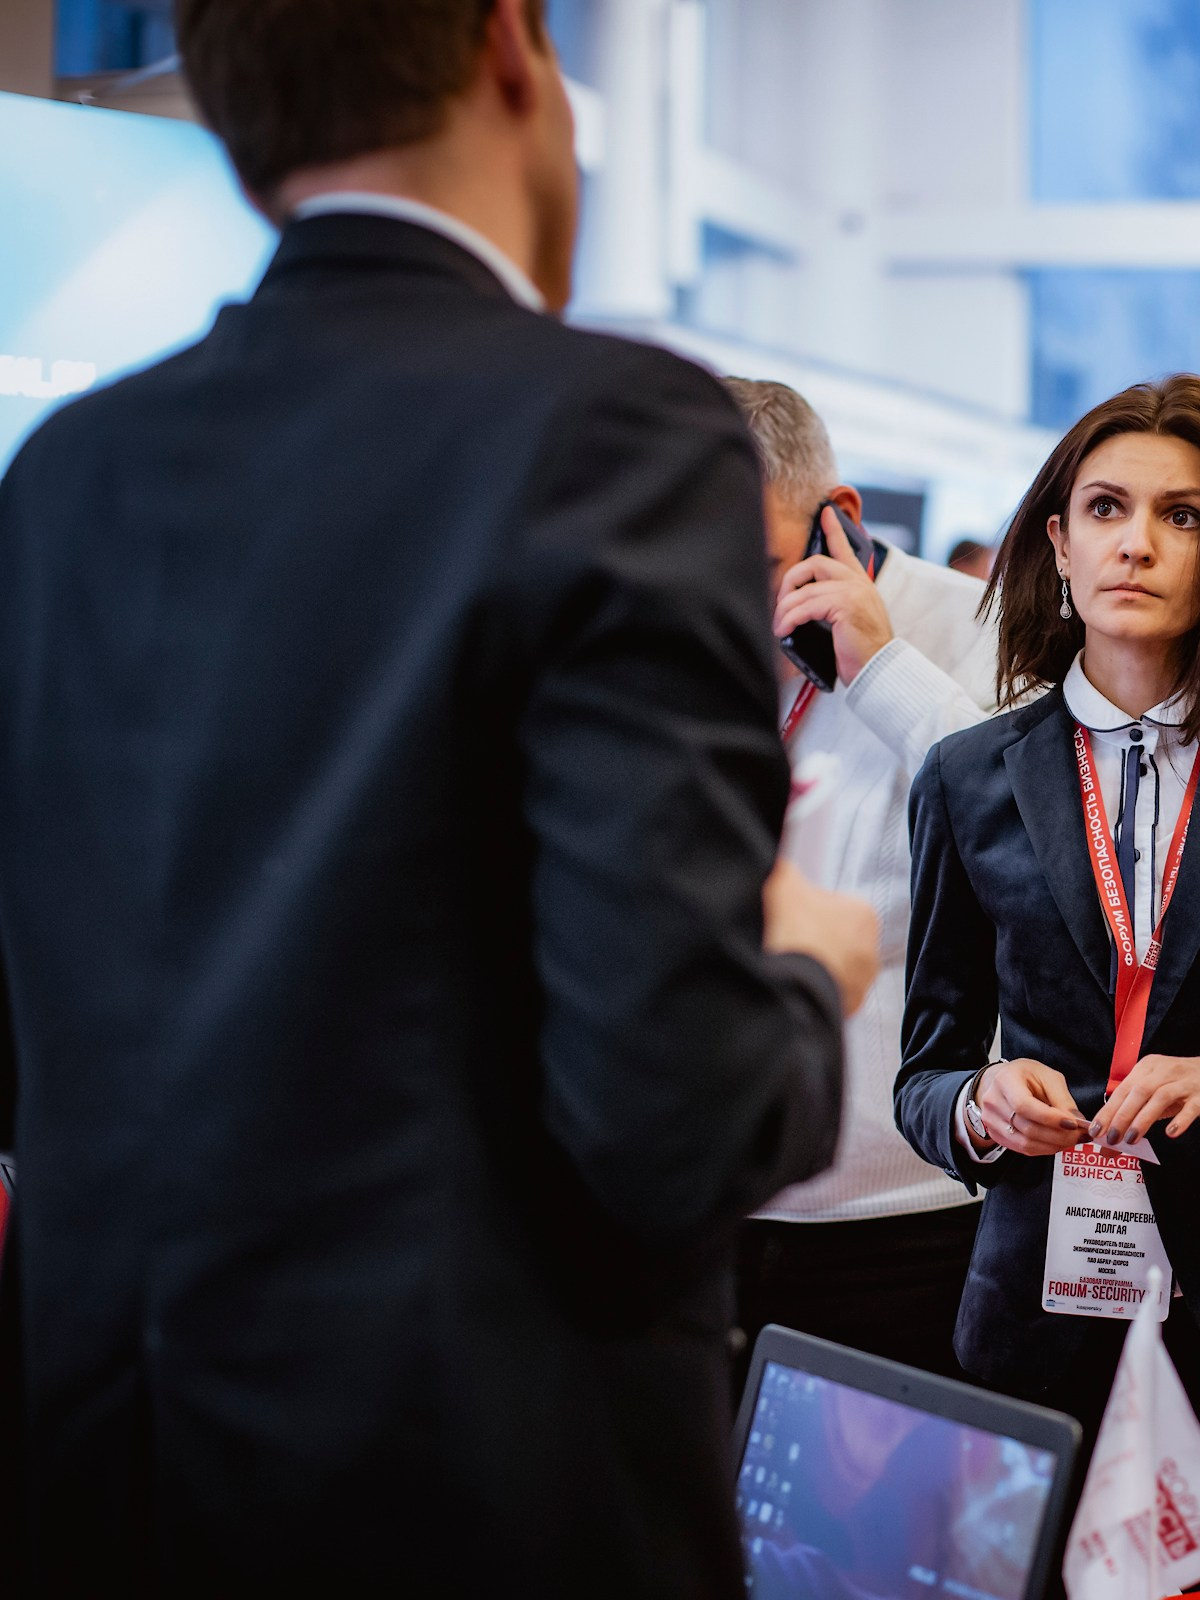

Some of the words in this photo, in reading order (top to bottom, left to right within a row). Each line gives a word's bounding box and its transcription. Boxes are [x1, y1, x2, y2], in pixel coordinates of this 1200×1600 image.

[1075, 727, 1094, 793] БИЗНЕСА
[1086, 793, 1121, 907] БЕЗОПАСНОСТЬ
[1115, 911, 1133, 967] ФОРУМ
[1063, 1165, 1123, 1182] БИЗНЕСА
[1065, 1206, 1111, 1220] АНАСТАСИЯ
[1094, 1222, 1127, 1235] ДОЛГАЯ
[1083, 1238, 1118, 1247] РУКОВОДИТЕЛЬ
[1118, 1241, 1136, 1249] ОТДЕЛА
[1073, 1245, 1110, 1255] ЭКОНОМИЧЕСКОЙ
[1111, 1249, 1145, 1258] БЕЗОПАСНОСТИ
[1079, 1276, 1102, 1285] БАЗОВАЯ
[1102, 1279, 1133, 1288] ПРОГРАММА
[1048, 1281, 1162, 1304] FORUM-SECURITY
[1076, 1304, 1102, 1312] kaspersky
